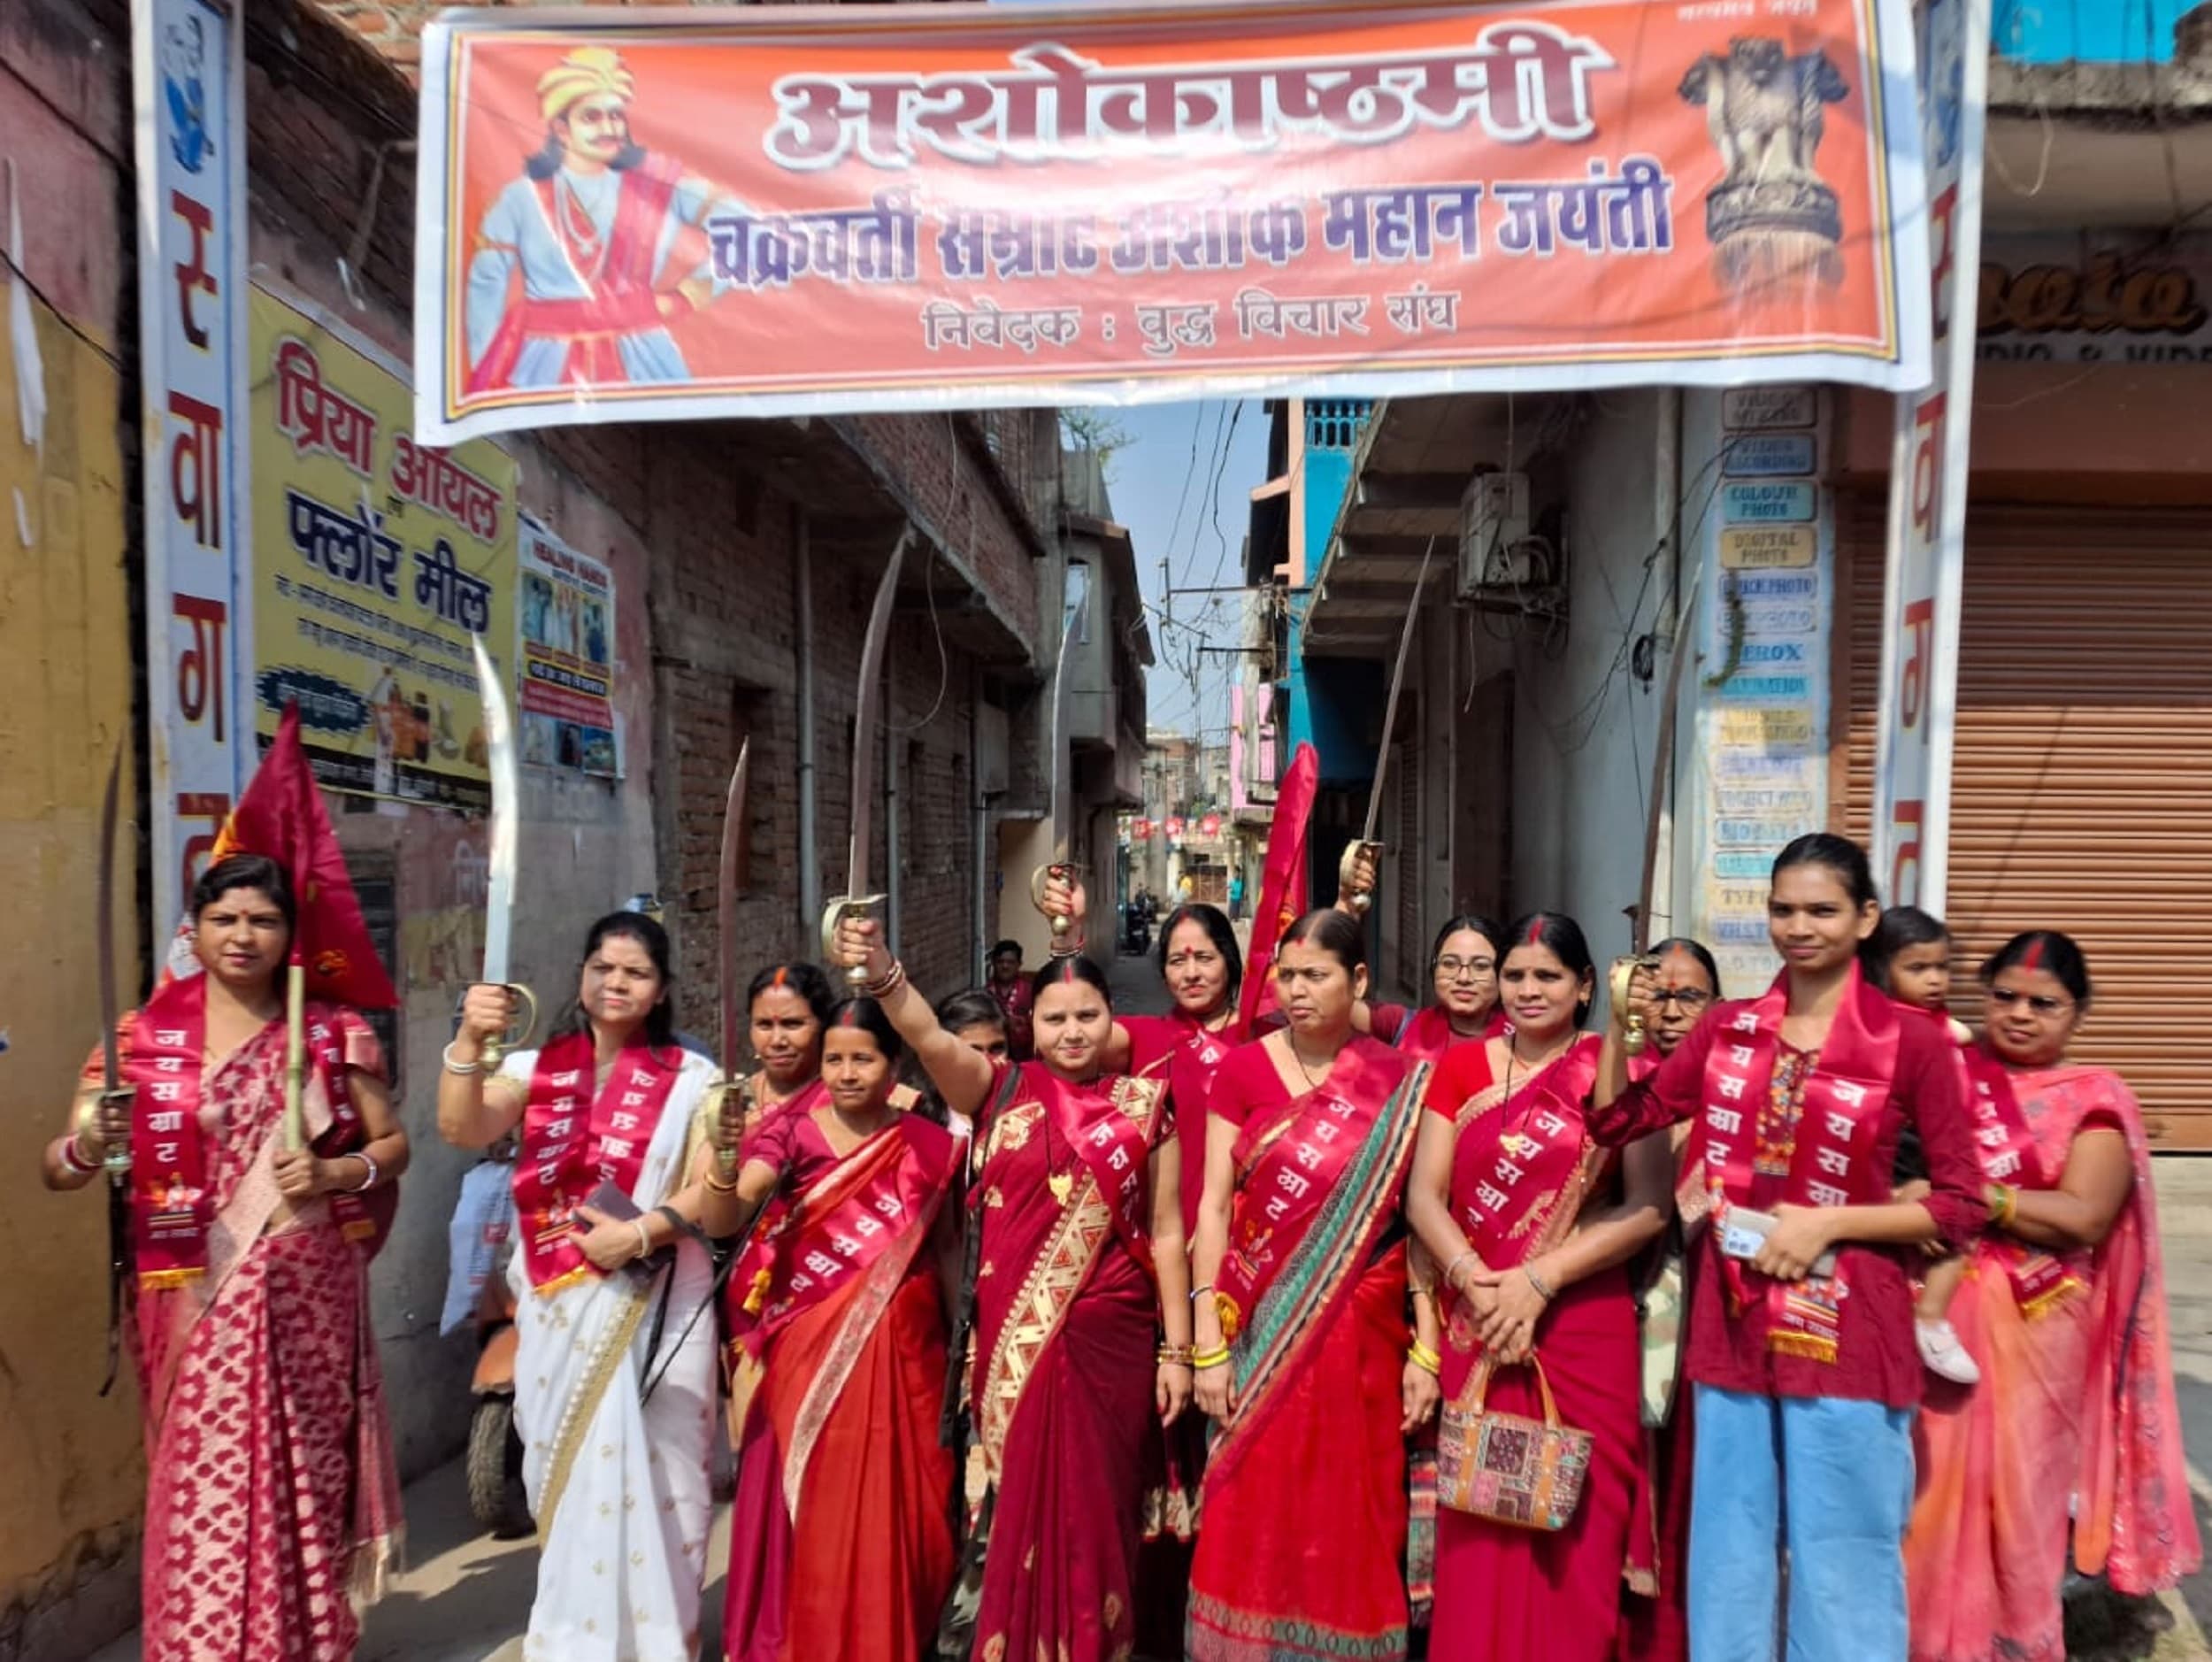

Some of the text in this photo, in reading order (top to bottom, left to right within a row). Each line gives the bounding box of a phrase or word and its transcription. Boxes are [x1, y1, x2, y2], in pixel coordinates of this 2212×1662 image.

[1323, 182, 1485, 262] महान
[1492, 158, 1674, 256] जयंती
[922, 297, 1082, 351] निवेदक
[1233, 289, 1370, 337] विचार
[276, 339, 379, 480] प्रिया
[414, 537, 493, 635] मील
